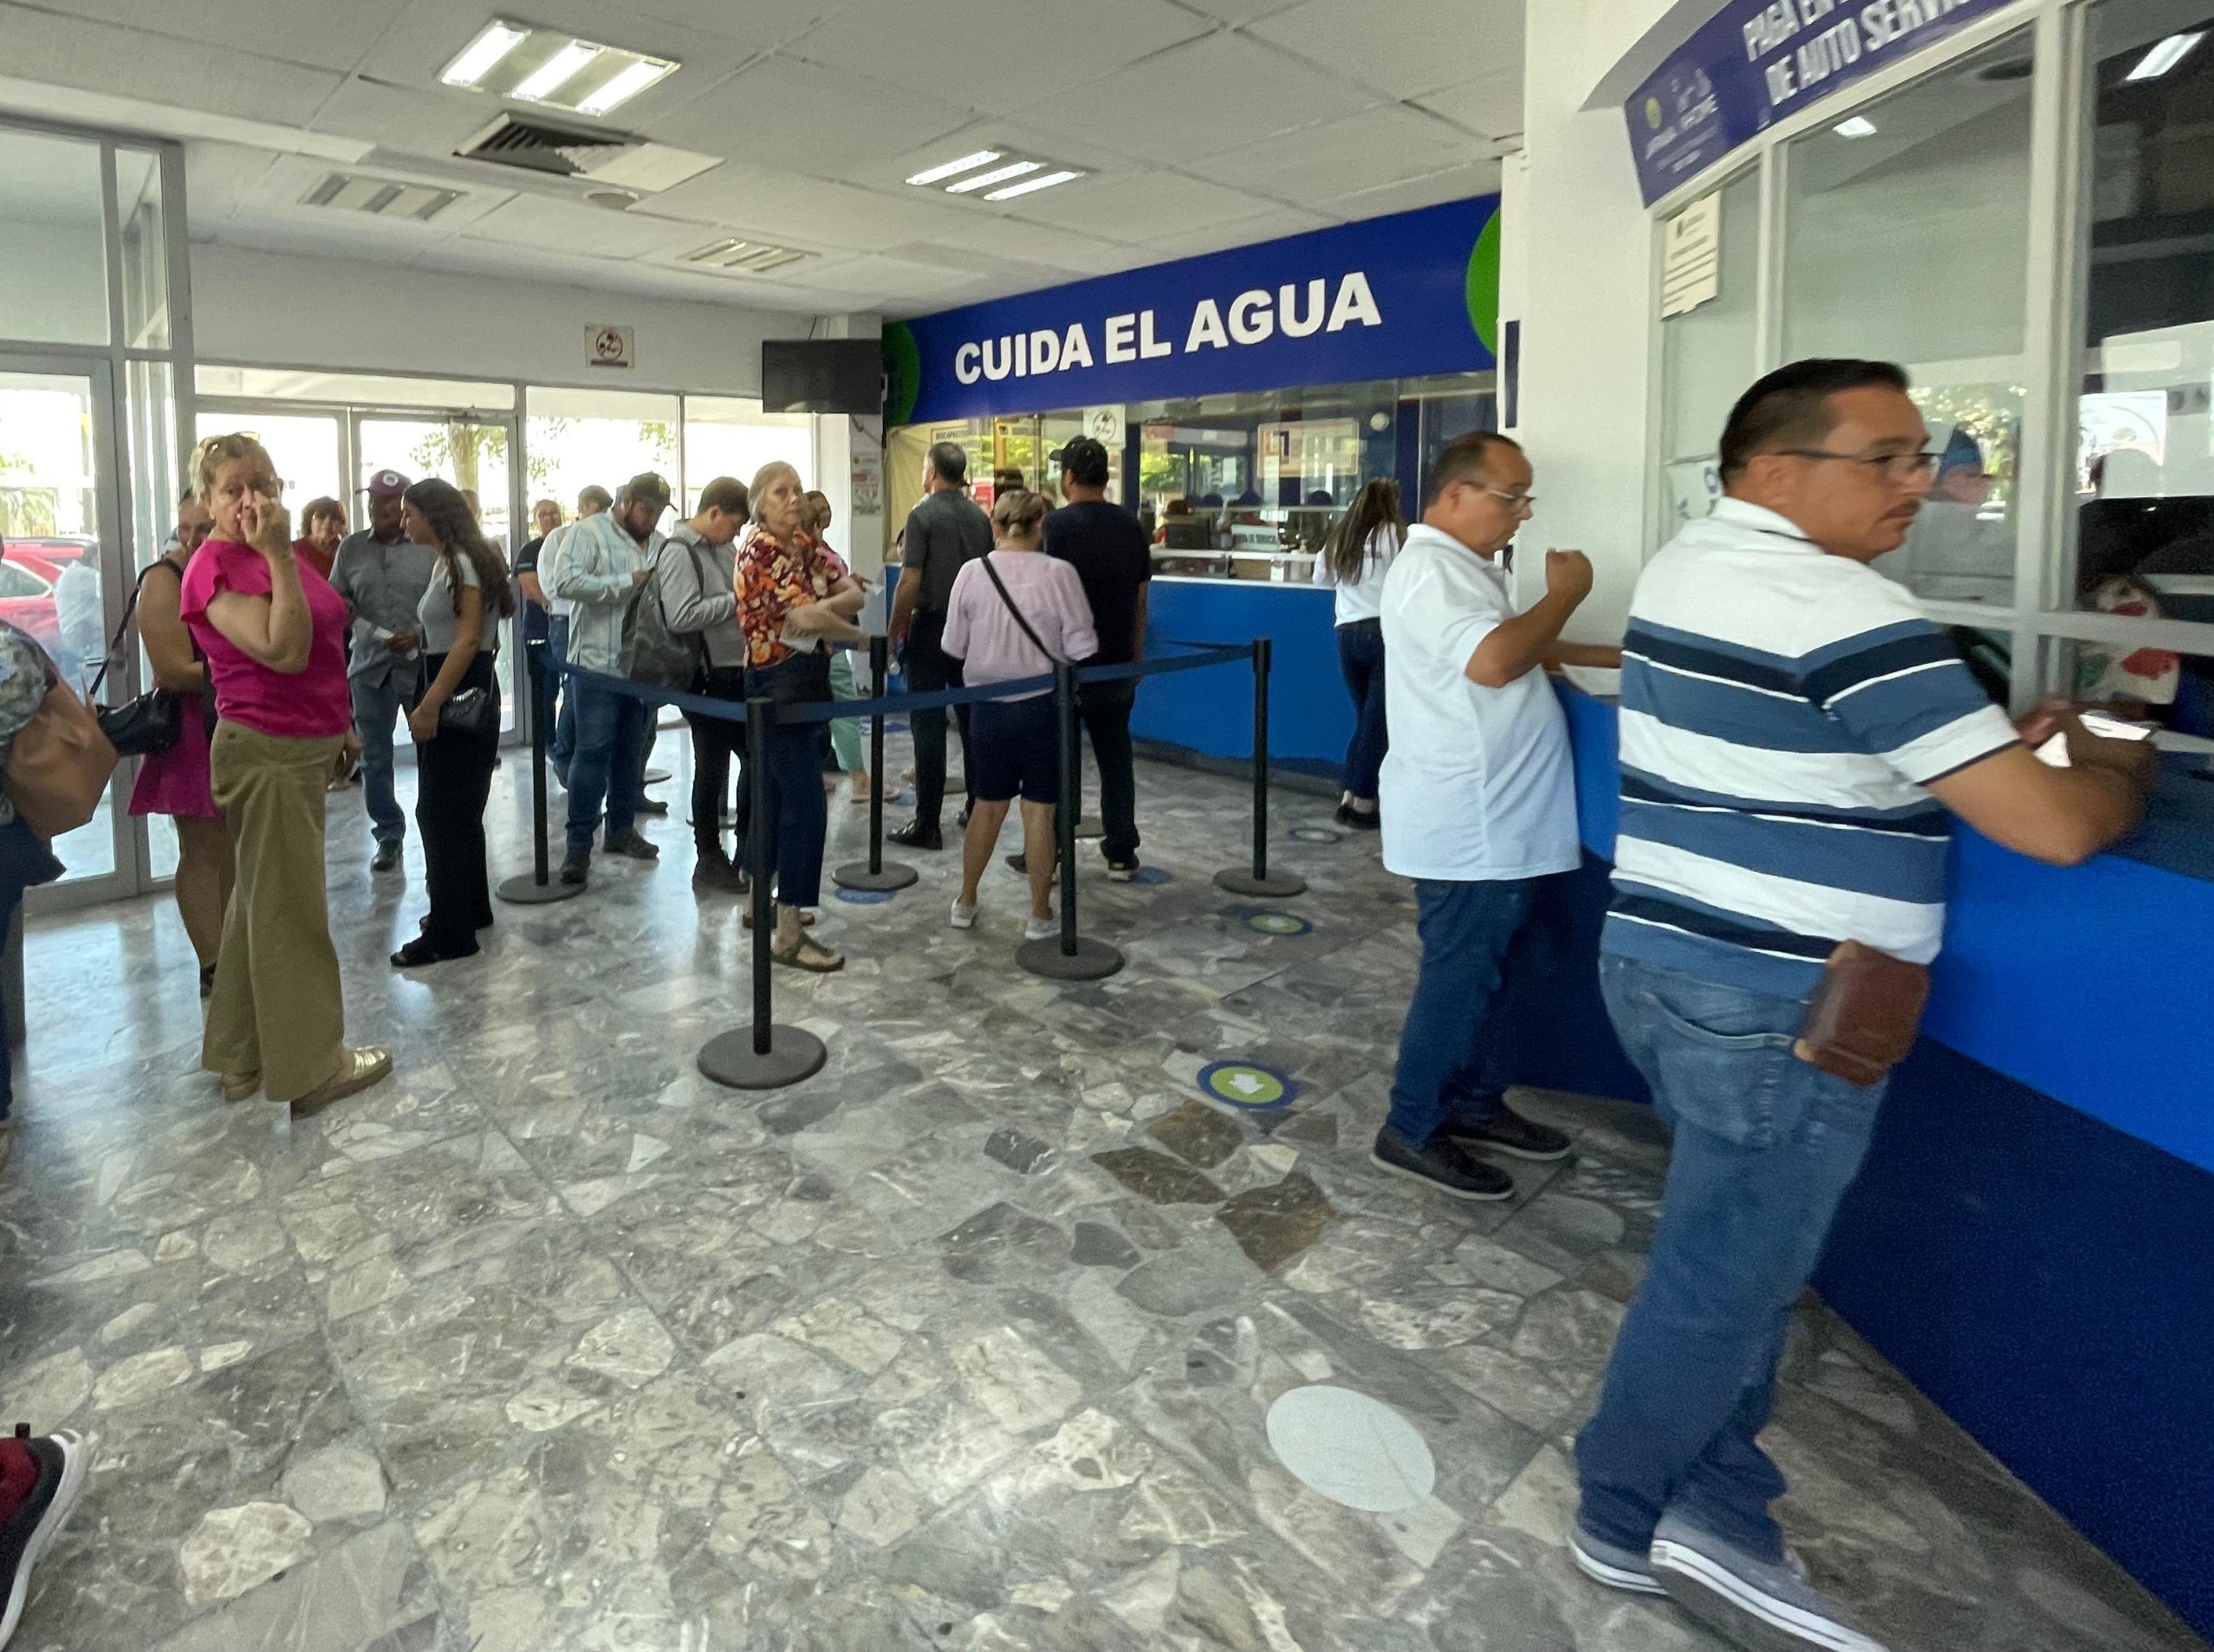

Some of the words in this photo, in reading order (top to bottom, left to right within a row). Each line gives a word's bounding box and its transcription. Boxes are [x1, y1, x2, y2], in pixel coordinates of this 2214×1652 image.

[1743, 0, 1801, 62] PAGA
[1765, 54, 1798, 106] DE
[1797, 17, 1862, 91] AUTO
[1861, 0, 1971, 52] SERV
[956, 323, 1094, 385] CUIDA
[1106, 310, 1172, 365] EL
[1185, 272, 1382, 353] AGUA
